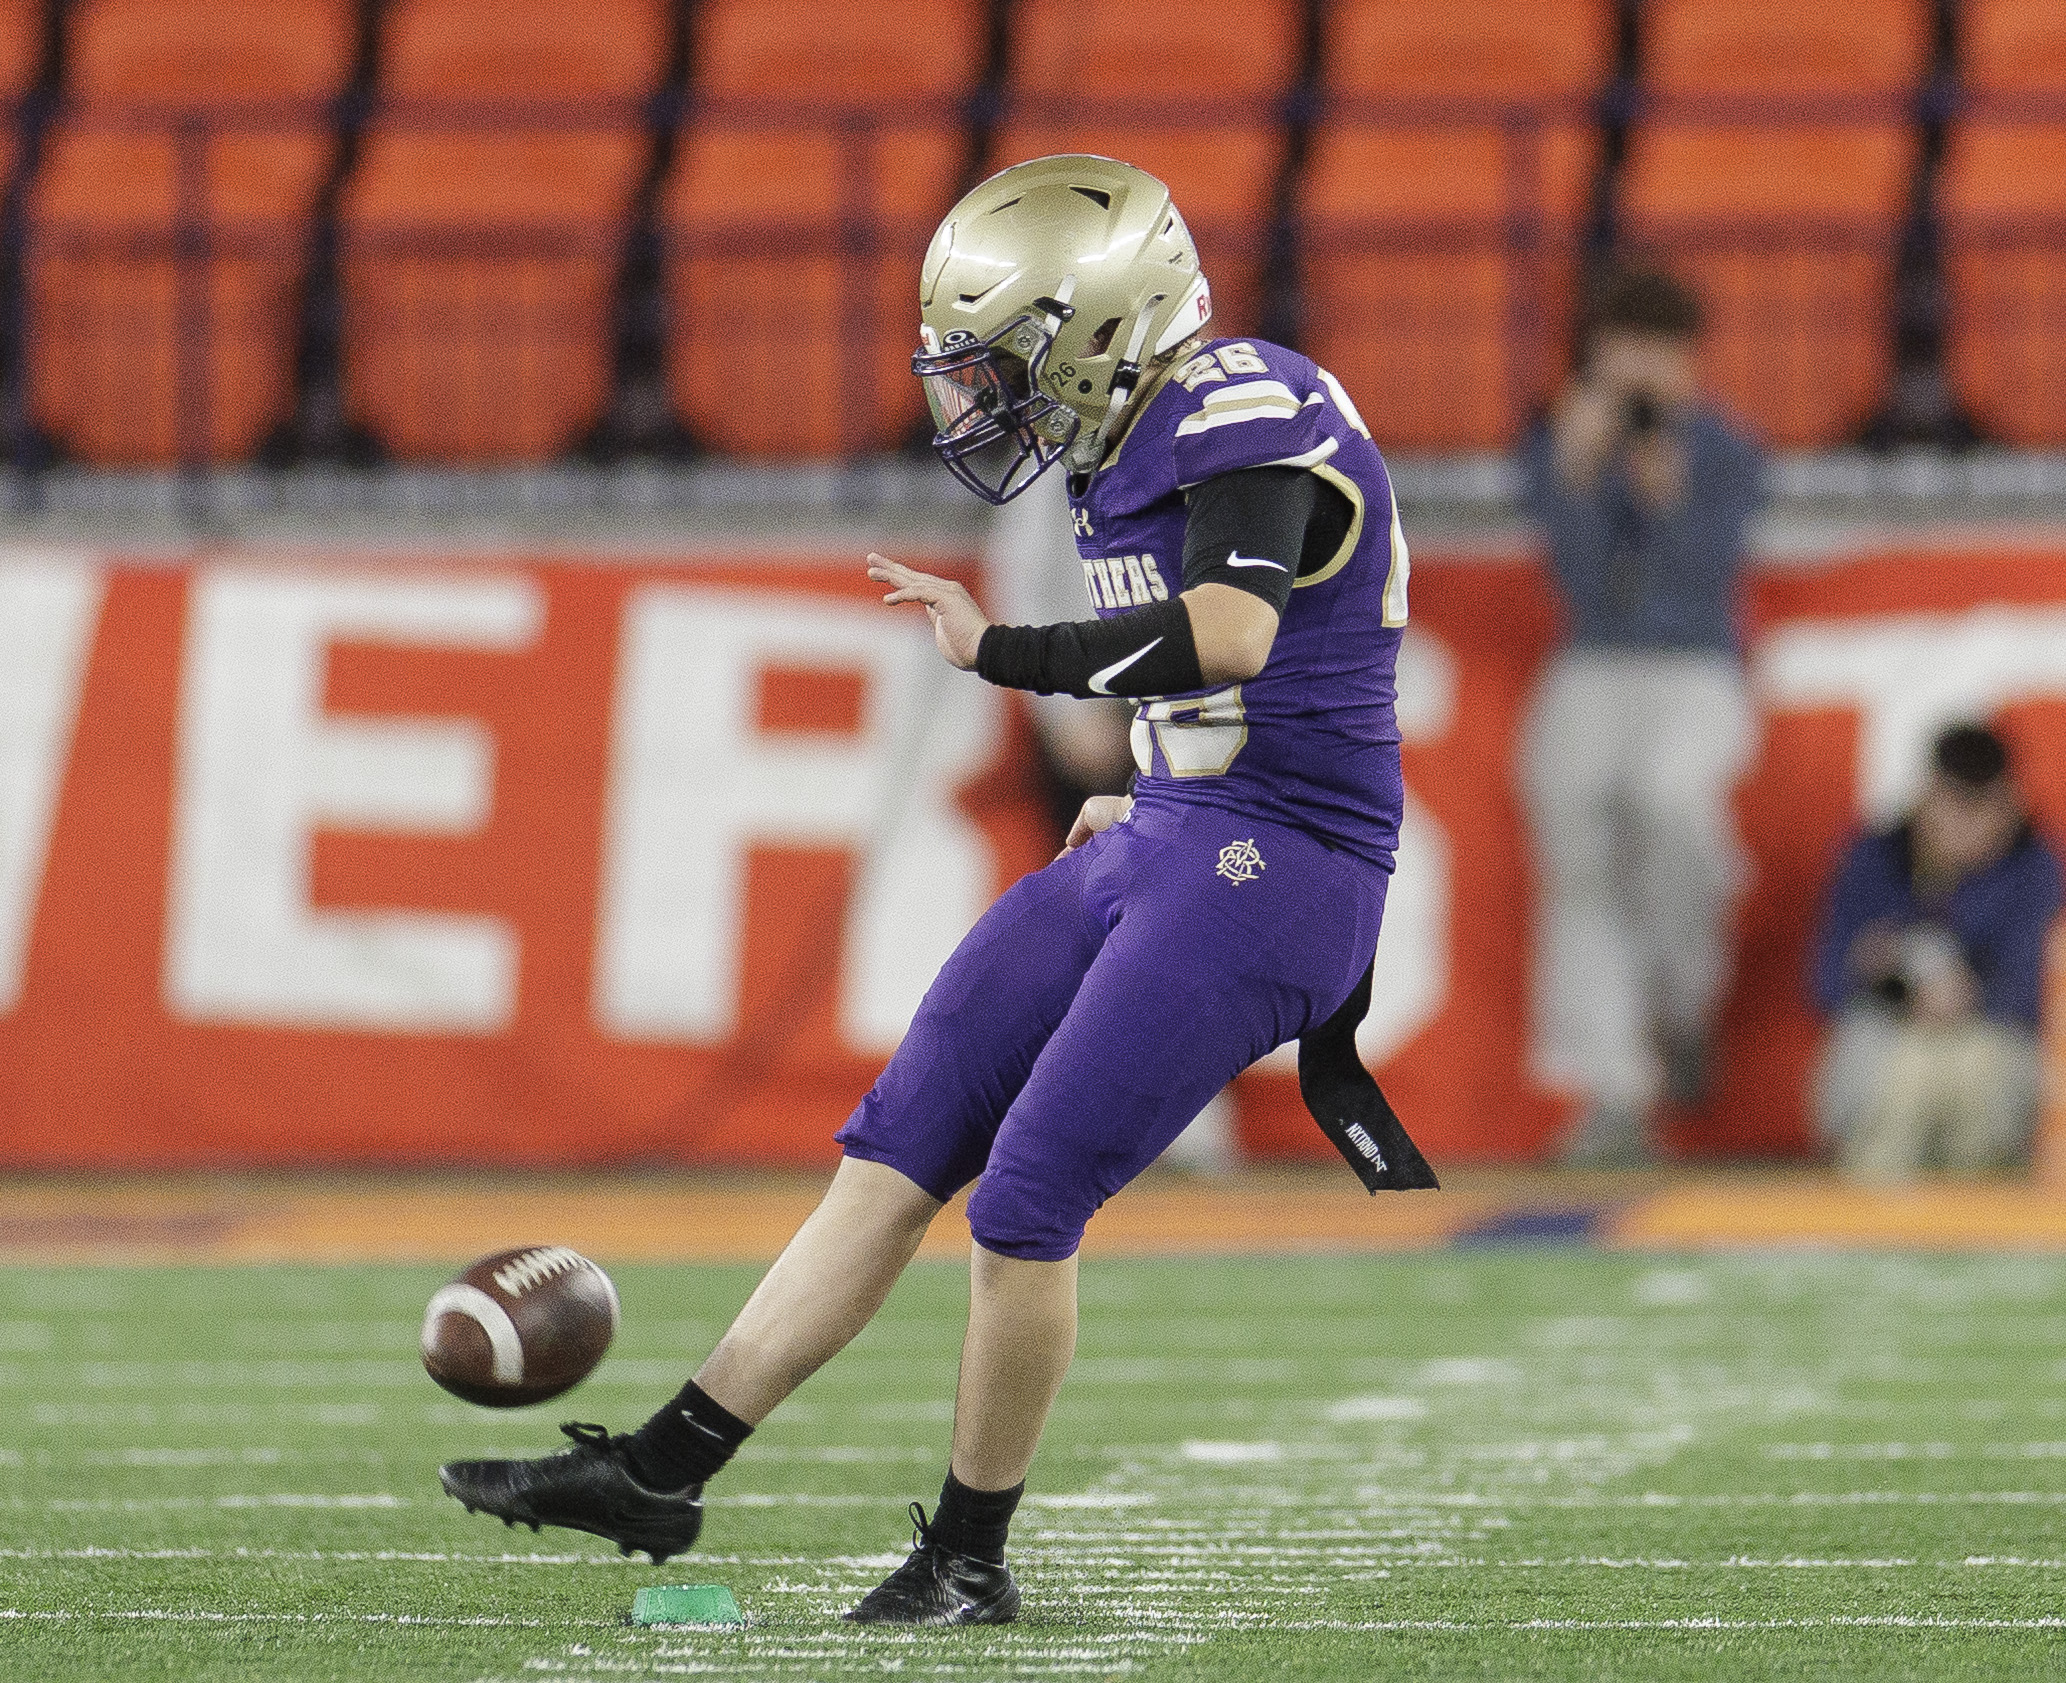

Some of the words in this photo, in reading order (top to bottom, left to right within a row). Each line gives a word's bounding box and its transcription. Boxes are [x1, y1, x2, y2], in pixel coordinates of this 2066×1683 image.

[1050, 361, 1077, 387] 26
[1173, 342, 1270, 393] 26
[1081, 553, 1169, 609] THERS
